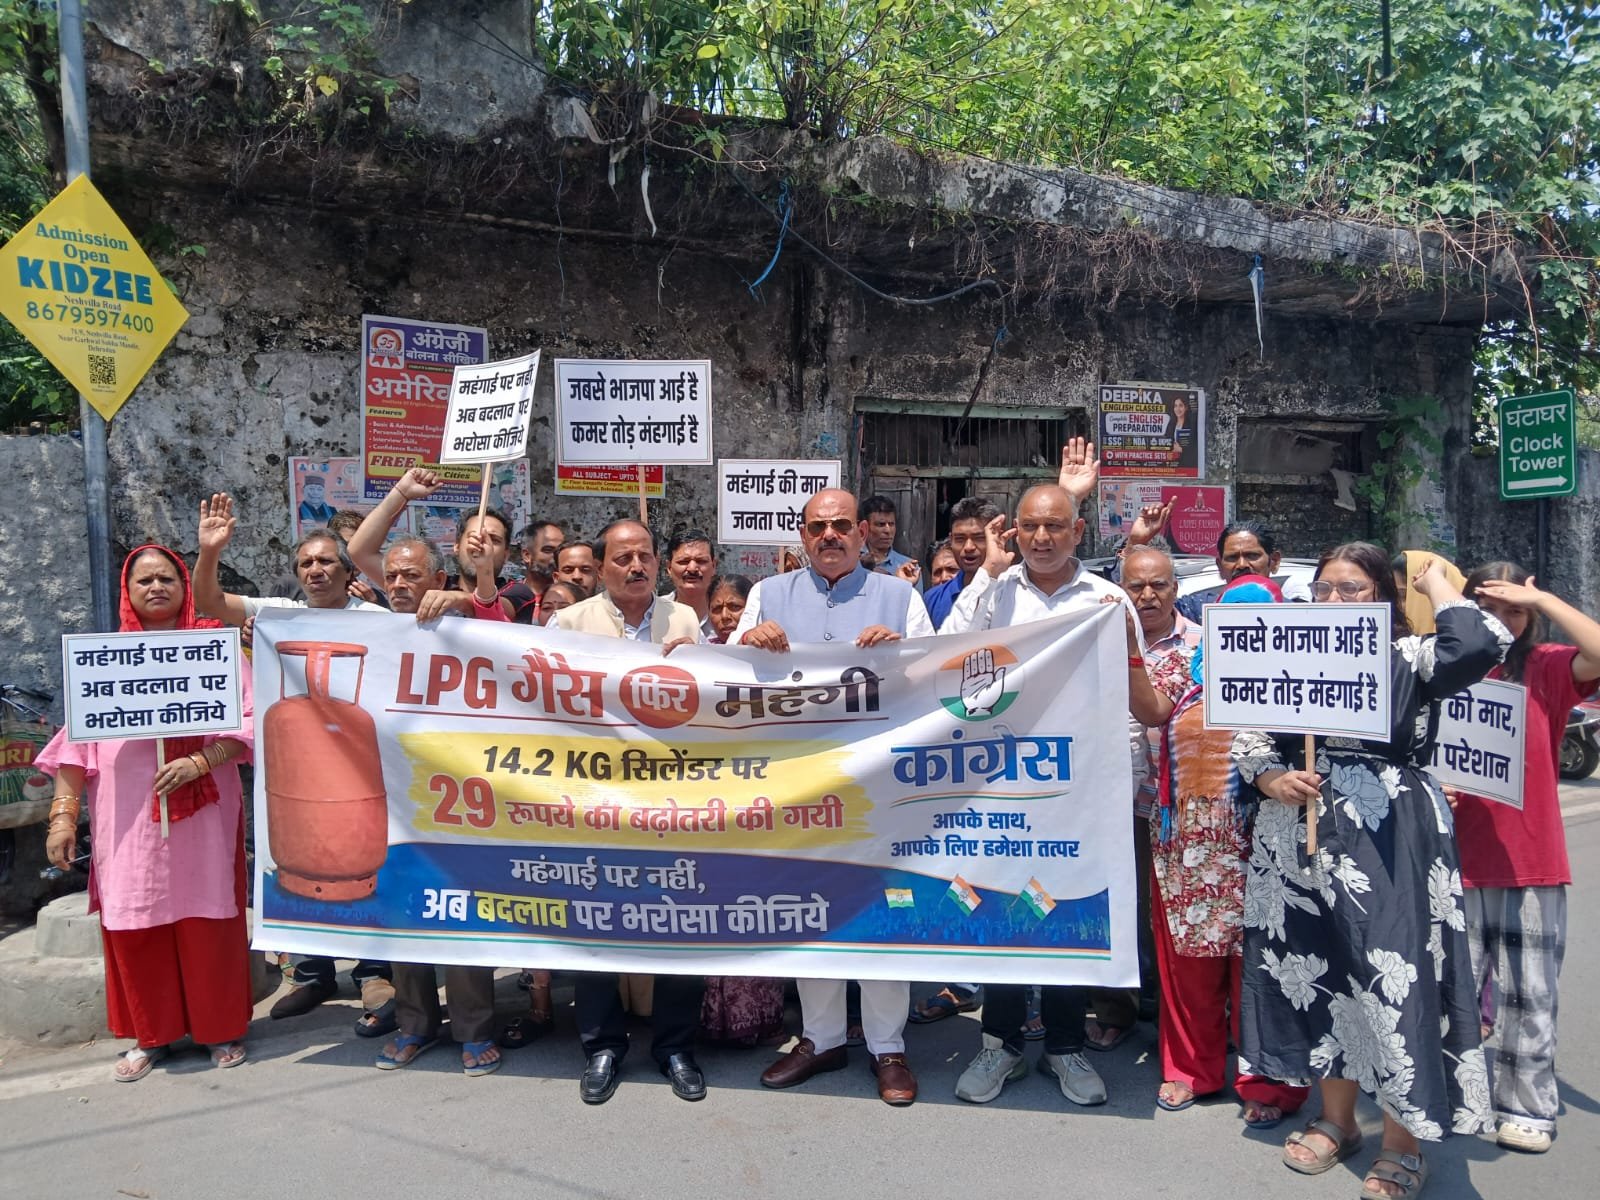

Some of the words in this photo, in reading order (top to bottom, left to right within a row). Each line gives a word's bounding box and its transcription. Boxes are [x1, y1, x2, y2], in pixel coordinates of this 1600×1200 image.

[35, 223, 129, 251] Admission
[64, 244, 110, 264] Open
[17, 256, 153, 305] KIDZEE
[64, 295, 100, 308] Neshvilla
[103, 301, 121, 311] Road
[26, 301, 153, 333] 8679597400
[412, 329, 471, 352] अंग्रेजी
[405, 347, 439, 362] बोलना
[459, 372, 499, 395] महंगाई
[500, 374, 515, 390] पर
[567, 372, 606, 401] जबसे
[609, 378, 655, 401] भाजपा
[658, 372, 686, 402] आई
[688, 372, 698, 401] है
[369, 408, 402, 416] Features
[456, 408, 478, 423] अब
[479, 402, 515, 422] बदलाव
[519, 398, 530, 415] पर
[1129, 414, 1164, 424] ENGLISH
[1505, 404, 1568, 428] घंटाघर
[454, 432, 492, 452] भरोसा
[493, 424, 524, 448] कीजिये
[570, 421, 608, 444] कमर
[610, 415, 636, 450] तोड़
[638, 416, 685, 446] मंहगाई
[688, 416, 698, 444] है
[1113, 424, 1162, 432] PREPARATION
[1108, 437, 1122, 446] SSC
[1133, 438, 1146, 446] NDA
[1510, 432, 1564, 454] Clock
[370, 456, 416, 468] FREE
[1508, 456, 1566, 472] Tower
[726, 469, 776, 496] महंगाई
[778, 469, 798, 494] की
[731, 511, 774, 530] जनता
[1218, 616, 1267, 652] जबसे
[1272, 626, 1330, 654] भाजपा
[1334, 617, 1364, 657] आई
[1366, 617, 1378, 656] है
[74, 643, 146, 667] महंगाई
[150, 646, 179, 664] पर
[182, 640, 229, 664] नहीं,
[81, 680, 116, 698] अब
[119, 676, 190, 696] बदलाव
[199, 674, 228, 691] पर
[396, 652, 500, 710] LPG
[630, 672, 690, 713] फिर
[714, 665, 885, 719] महंगी
[1220, 677, 1269, 704] कमर
[1272, 670, 1304, 714] तोड़
[1307, 672, 1364, 712] मंहगाई
[1366, 672, 1378, 711] है
[85, 706, 154, 729] भरोसा
[157, 700, 226, 724] कीजिये
[1448, 689, 1474, 723] की
[1478, 698, 1516, 738] मार,
[484, 745, 553, 778] 14.2
[565, 750, 612, 780] KG
[620, 748, 726, 782] सिलेंडर
[730, 756, 770, 780] पर
[890, 724, 1074, 787] कांग्रेस
[1444, 738, 1510, 783] परेशान
[428, 773, 497, 830] 29
[504, 795, 576, 830] रूपये
[627, 796, 727, 840] बढ़ोतरी
[735, 796, 774, 832] की
[782, 793, 844, 830] गयी
[932, 808, 984, 830] आपके
[987, 812, 1032, 832] साथ,
[890, 835, 942, 858] आपके
[944, 834, 980, 858] लिए
[984, 835, 1034, 858] हमेशा
[1037, 840, 1080, 858] तत्पर
[510, 854, 598, 890] महंगाई
[603, 868, 640, 889] पर
[646, 858, 706, 894] नहीं,
[422, 888, 470, 922] अब
[474, 890, 568, 930] बदलाव
[572, 900, 618, 931] पर
[622, 894, 720, 934] भरोसा
[723, 892, 830, 934] कीजिये
